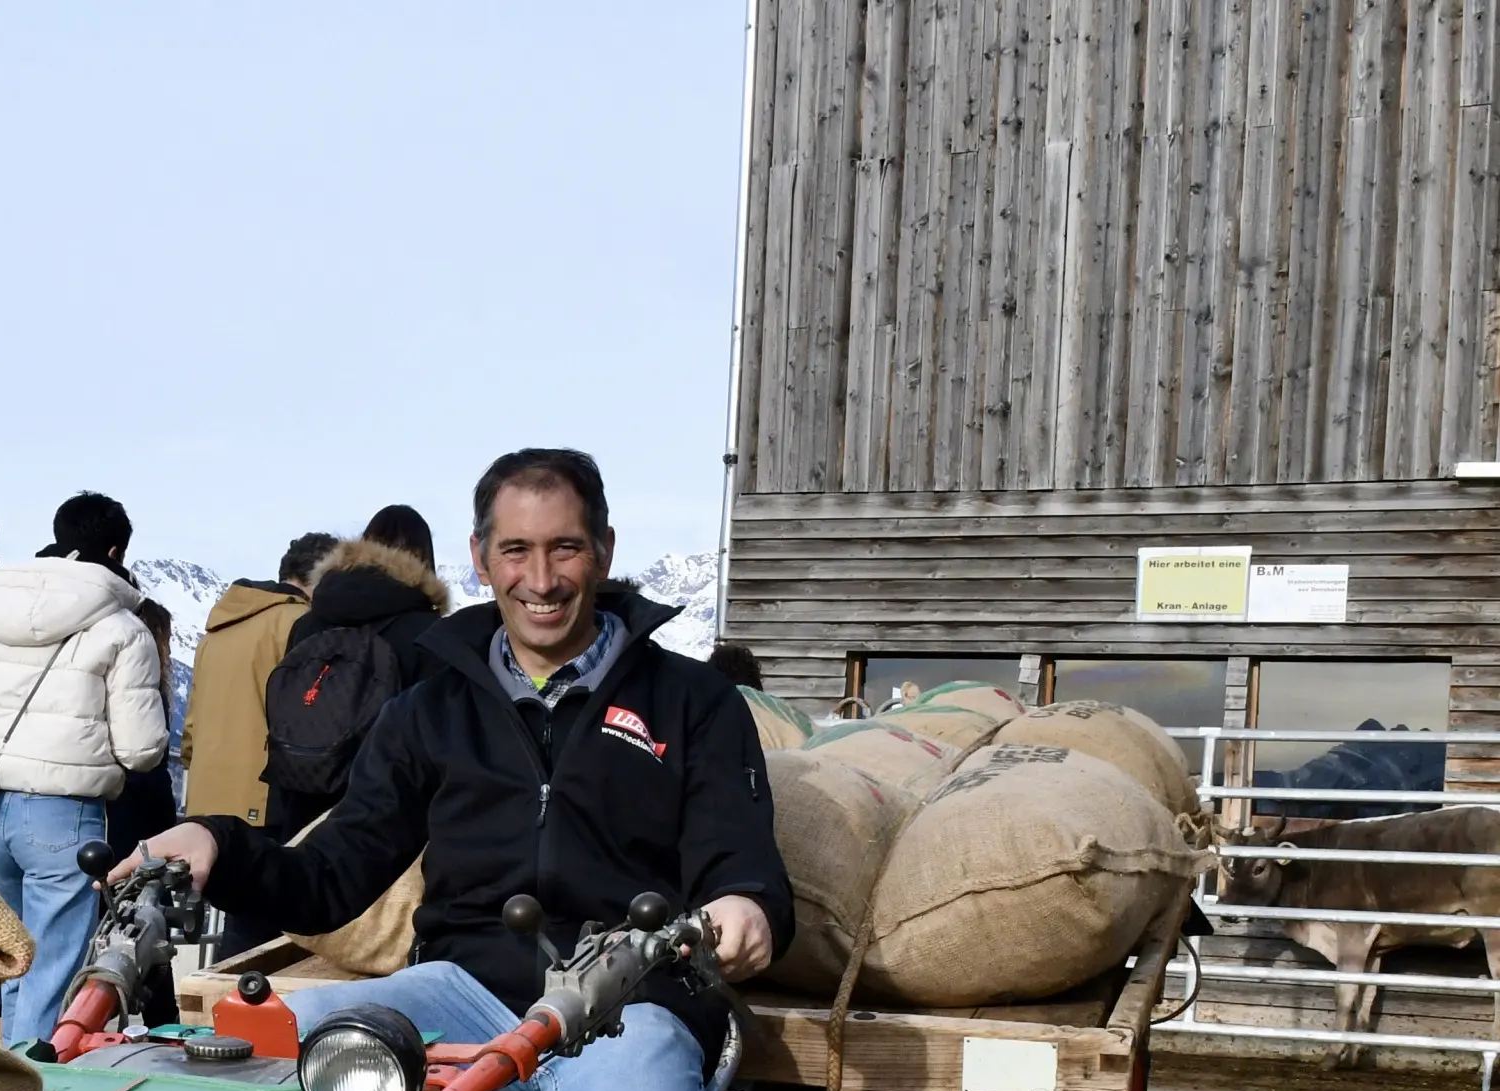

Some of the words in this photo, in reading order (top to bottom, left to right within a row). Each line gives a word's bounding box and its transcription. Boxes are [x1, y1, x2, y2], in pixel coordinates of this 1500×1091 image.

[1148, 560, 1171, 568] Hier
[1173, 559, 1215, 568] arbeitet
[1218, 560, 1242, 568] eine
[1156, 602, 1182, 610] Kran
[1191, 602, 1228, 611] Anlage
